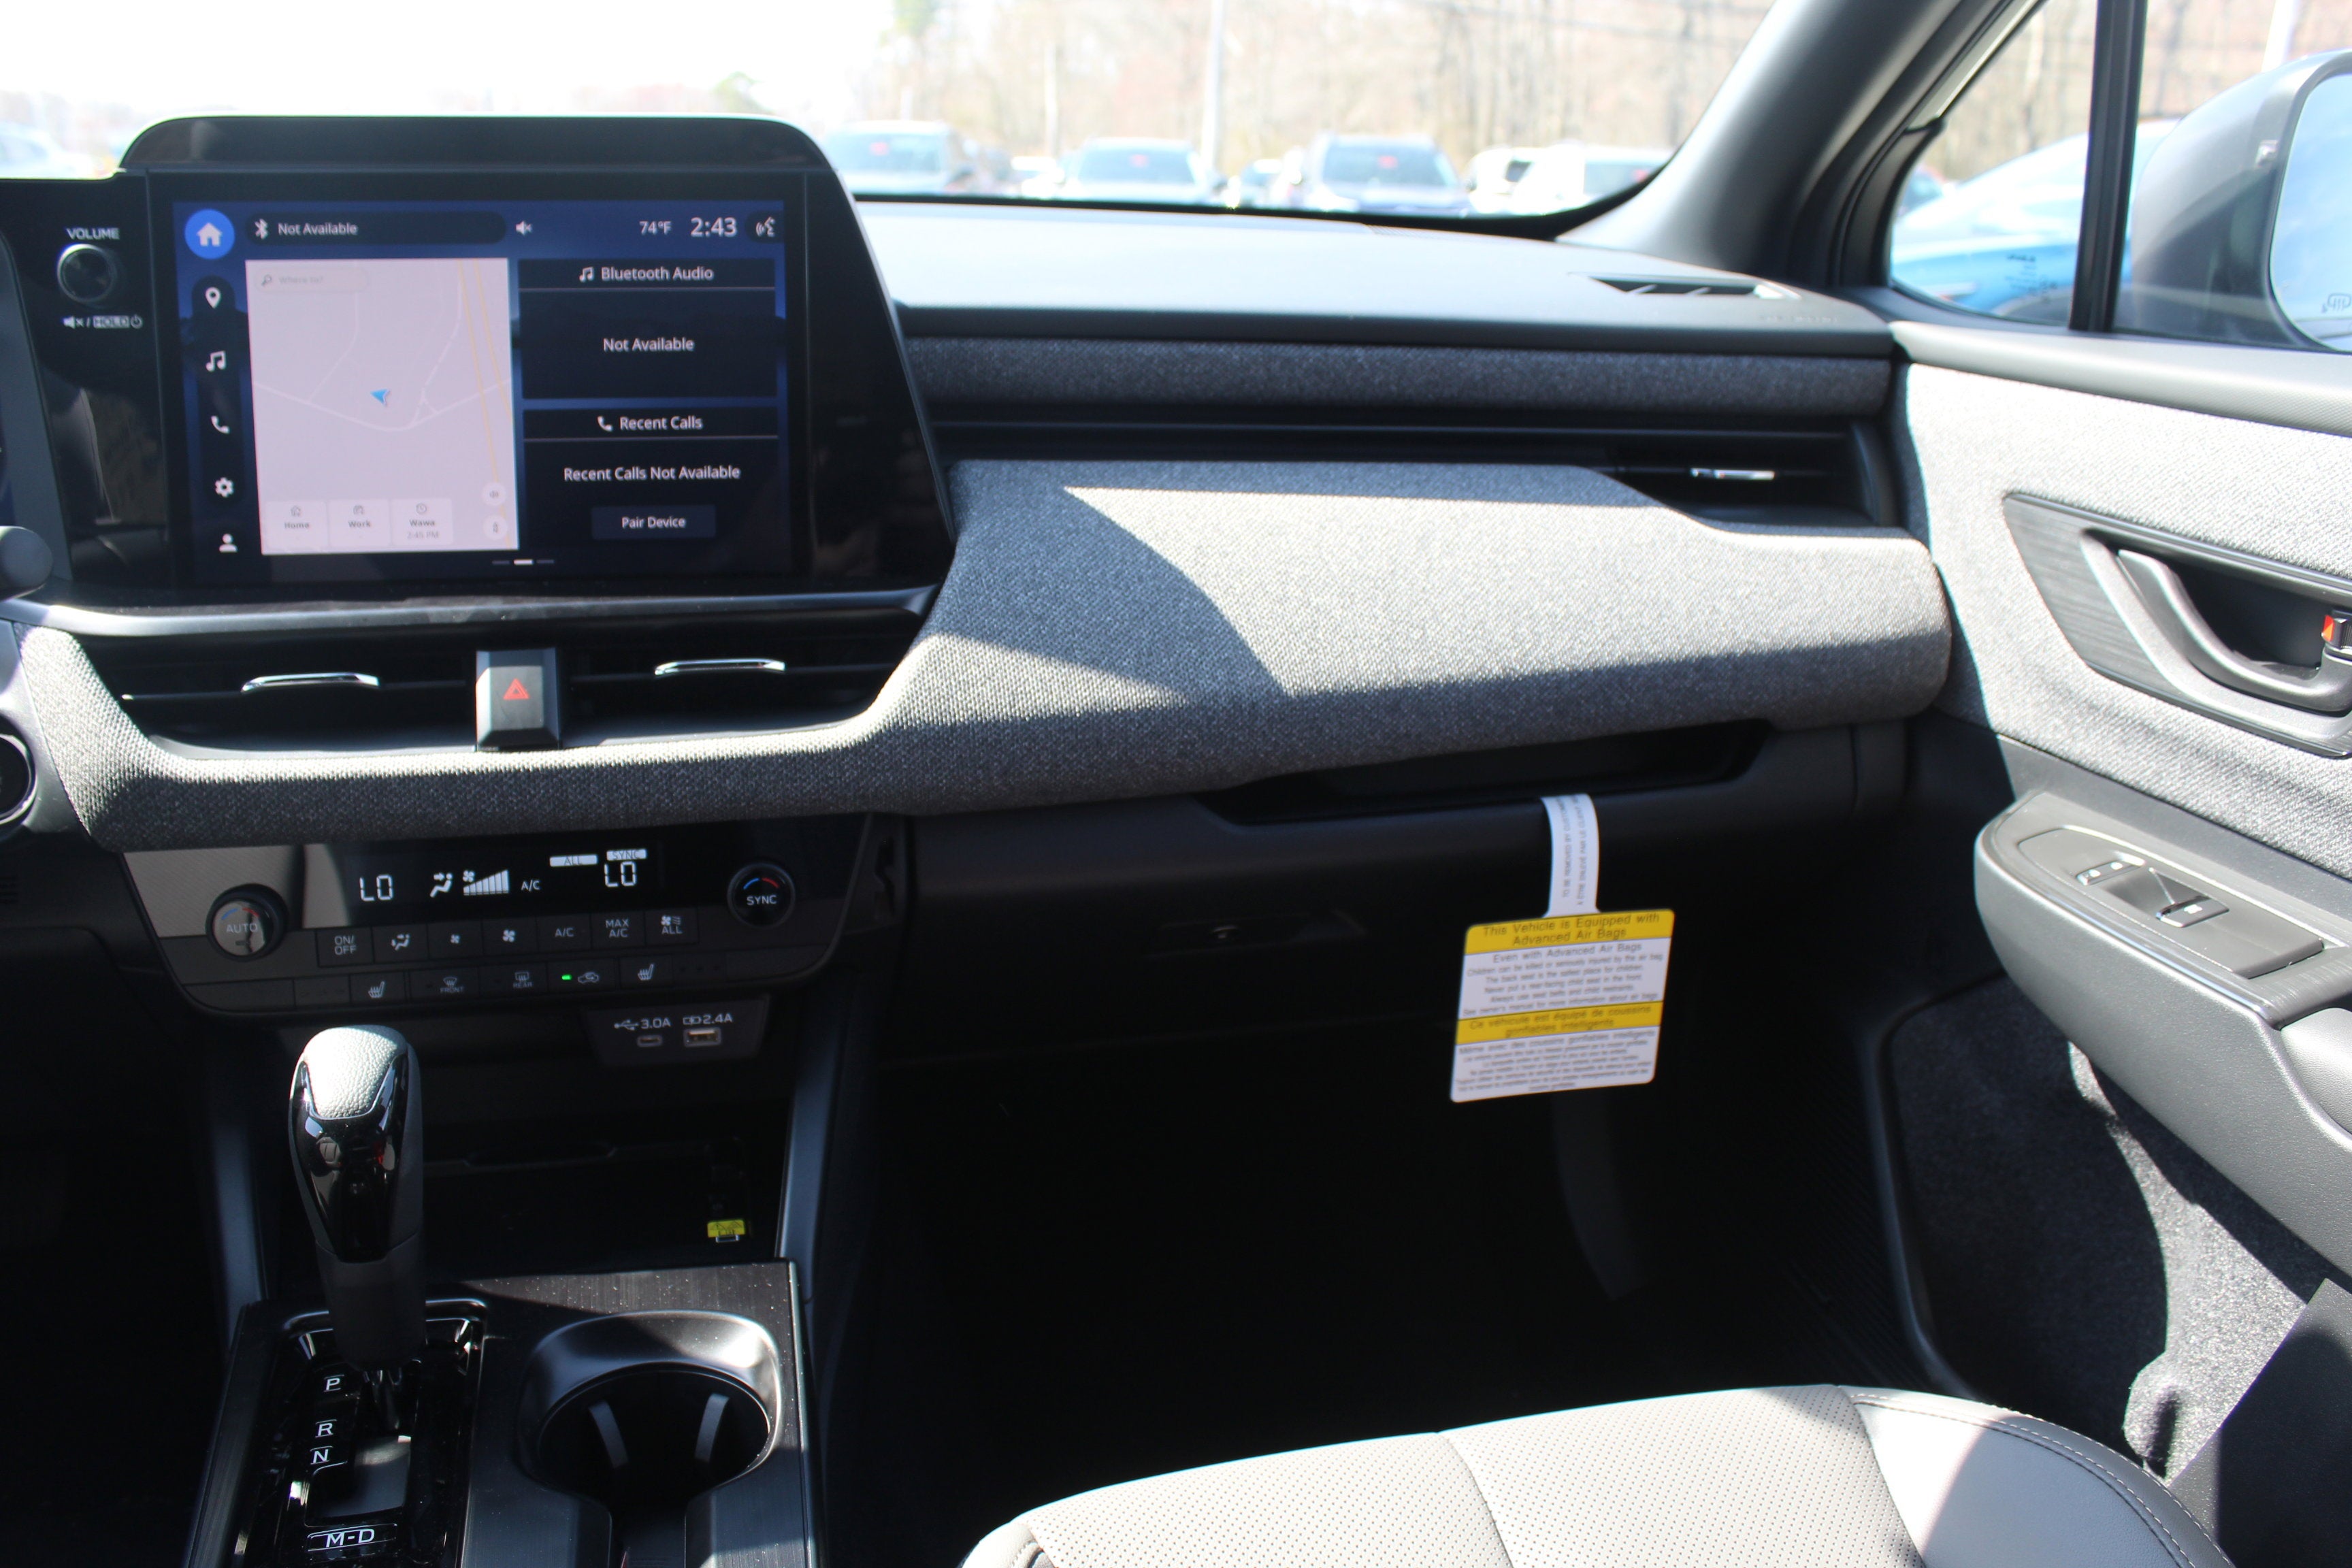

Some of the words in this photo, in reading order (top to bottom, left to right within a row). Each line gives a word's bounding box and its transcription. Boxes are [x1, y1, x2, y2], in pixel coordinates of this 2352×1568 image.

[278, 223, 301, 235] Not
[303, 222, 359, 235] Available
[690, 216, 737, 237] 2:43
[67, 227, 120, 240] VOLUME
[601, 266, 670, 281] Bluetooth
[672, 266, 714, 280] Audio
[93, 315, 129, 329] HOLD
[603, 338, 629, 352] Not
[632, 337, 695, 352] Available
[620, 416, 668, 431] Recent
[670, 415, 703, 430] Calls
[564, 467, 611, 482] Recent
[615, 466, 647, 481] Calls
[650, 466, 676, 480] Not
[679, 465, 741, 480] Available
[284, 521, 310, 529] Home
[348, 520, 371, 528] Work
[621, 517, 644, 529] Pair
[647, 517, 687, 529] Device
[425, 530, 439, 538] PM
[521, 879, 540, 891] A/C
[747, 895, 777, 905] SYNC
[227, 924, 257, 933] AUTO
[606, 919, 630, 928] MAX
[662, 925, 682, 934] ALL
[1484, 926, 1507, 937] This
[1513, 922, 1555, 934] Vehicle
[1560, 921, 1570, 930] is
[1575, 914, 1631, 928] Equipped
[1636, 913, 1660, 924] with
[555, 927, 574, 938] A/C
[608, 928, 627, 938] A/C
[1512, 933, 1571, 947] Advanced
[1577, 930, 1592, 940] Air
[1597, 927, 1627, 941] Bags
[334, 934, 355, 946] ON/
[334, 945, 356, 956] OFF
[1493, 954, 1518, 964] Even
[1522, 951, 1543, 960] with
[1547, 946, 1595, 958] Advanced
[1600, 944, 1613, 953] Air
[1616, 942, 1642, 953] Bags
[640, 1018, 670, 1029] 3.0A
[702, 1013, 732, 1024] 2.4A
[326, 1378, 340, 1390] P
[318, 1423, 333, 1436] R
[312, 1449, 329, 1463] N
[326, 1529, 374, 1548] M-D
